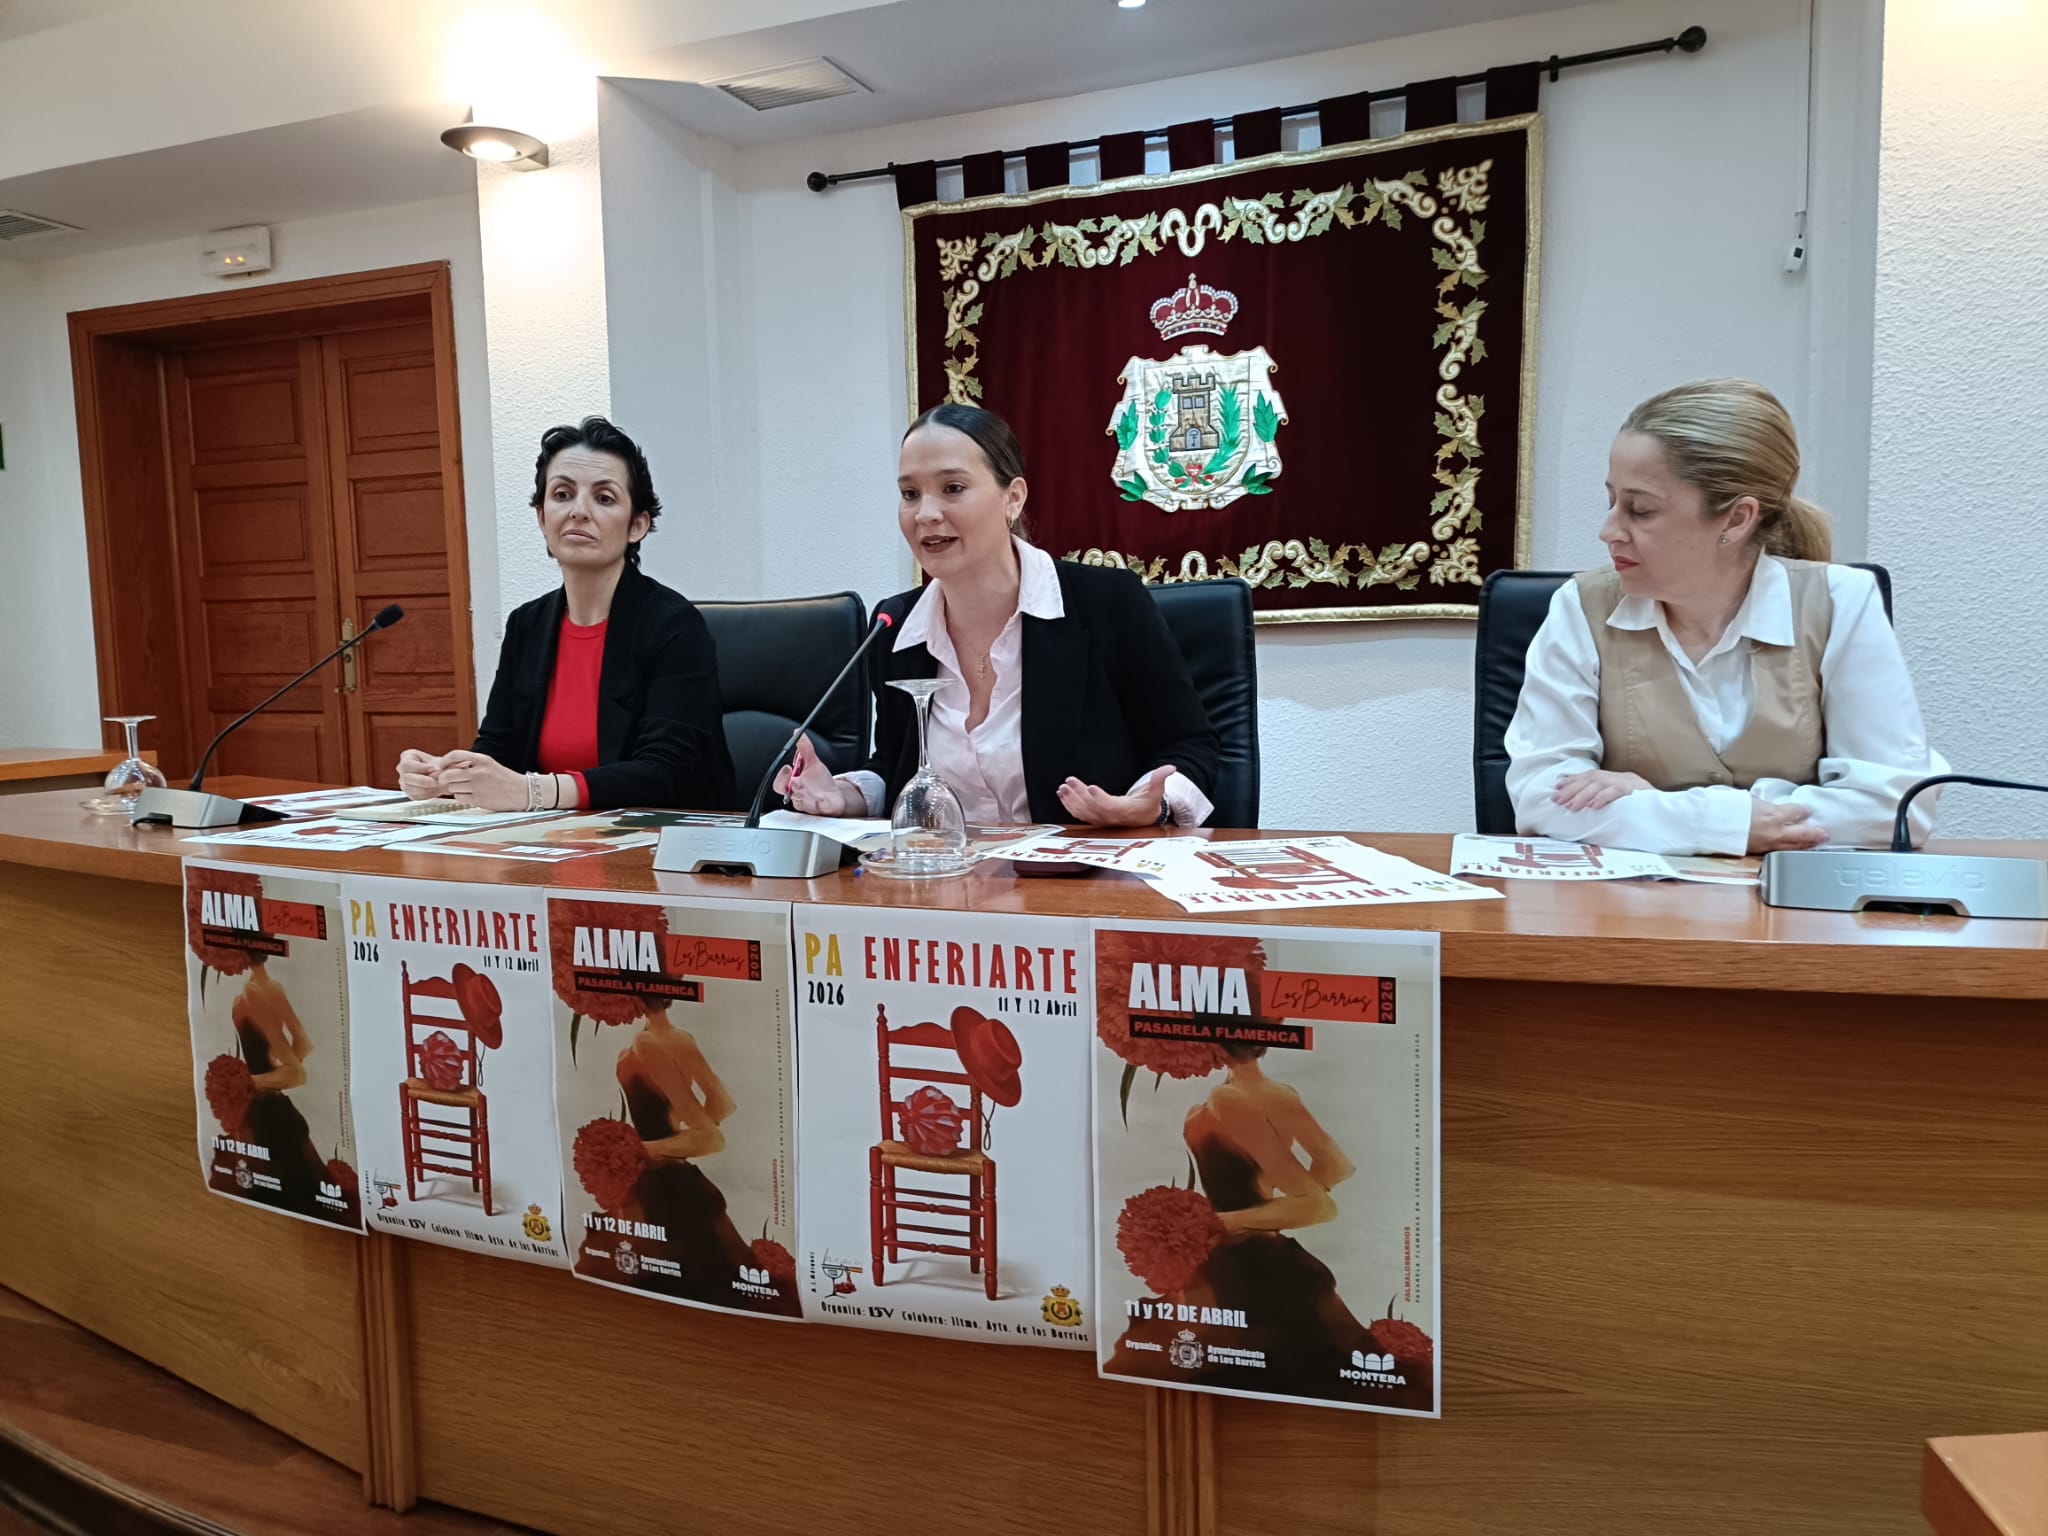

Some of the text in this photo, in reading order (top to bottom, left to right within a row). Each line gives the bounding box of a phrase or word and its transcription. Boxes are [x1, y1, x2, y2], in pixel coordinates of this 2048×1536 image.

[1833, 862, 1987, 892] televic
[1189, 887, 1413, 904] ENFERIARTE
[201, 890, 261, 932] ALMA
[350, 899, 538, 952] PA ENFERIARTE
[353, 941, 379, 963] 2026
[573, 926, 660, 973] ALMA
[750, 943, 760, 979] 2026
[495, 955, 500, 969] Y
[505, 956, 513, 970] 12
[517, 957, 540, 972] Abril
[804, 932, 1077, 994] PA ENFERIARTE
[578, 976, 695, 997] PASARELA FLAMENCA
[808, 980, 844, 1006] 2026
[1128, 962, 1251, 1016] ALMA
[1015, 997, 1021, 1013] Y
[1029, 998, 1040, 1015] 12
[1046, 999, 1077, 1017] Abril
[1380, 981, 1393, 1022] 2026
[1134, 1020, 1299, 1044] PASARELA FLAMENCA
[582, 1213, 593, 1228] 11
[603, 1217, 616, 1232] 12
[618, 1219, 633, 1235] DE
[634, 1221, 667, 1242] ABRIL
[732, 1281, 780, 1297] MONTERA
[1124, 1300, 1248, 1328] 11 y 12 DE ABRIL
[1016, 1323, 1028, 1335] de
[1032, 1325, 1046, 1337] los
[1051, 1328, 1089, 1342] Barrios
[1207, 1344, 1265, 1359] Ayuntamiento
[1339, 1368, 1407, 1385] MONTERA
